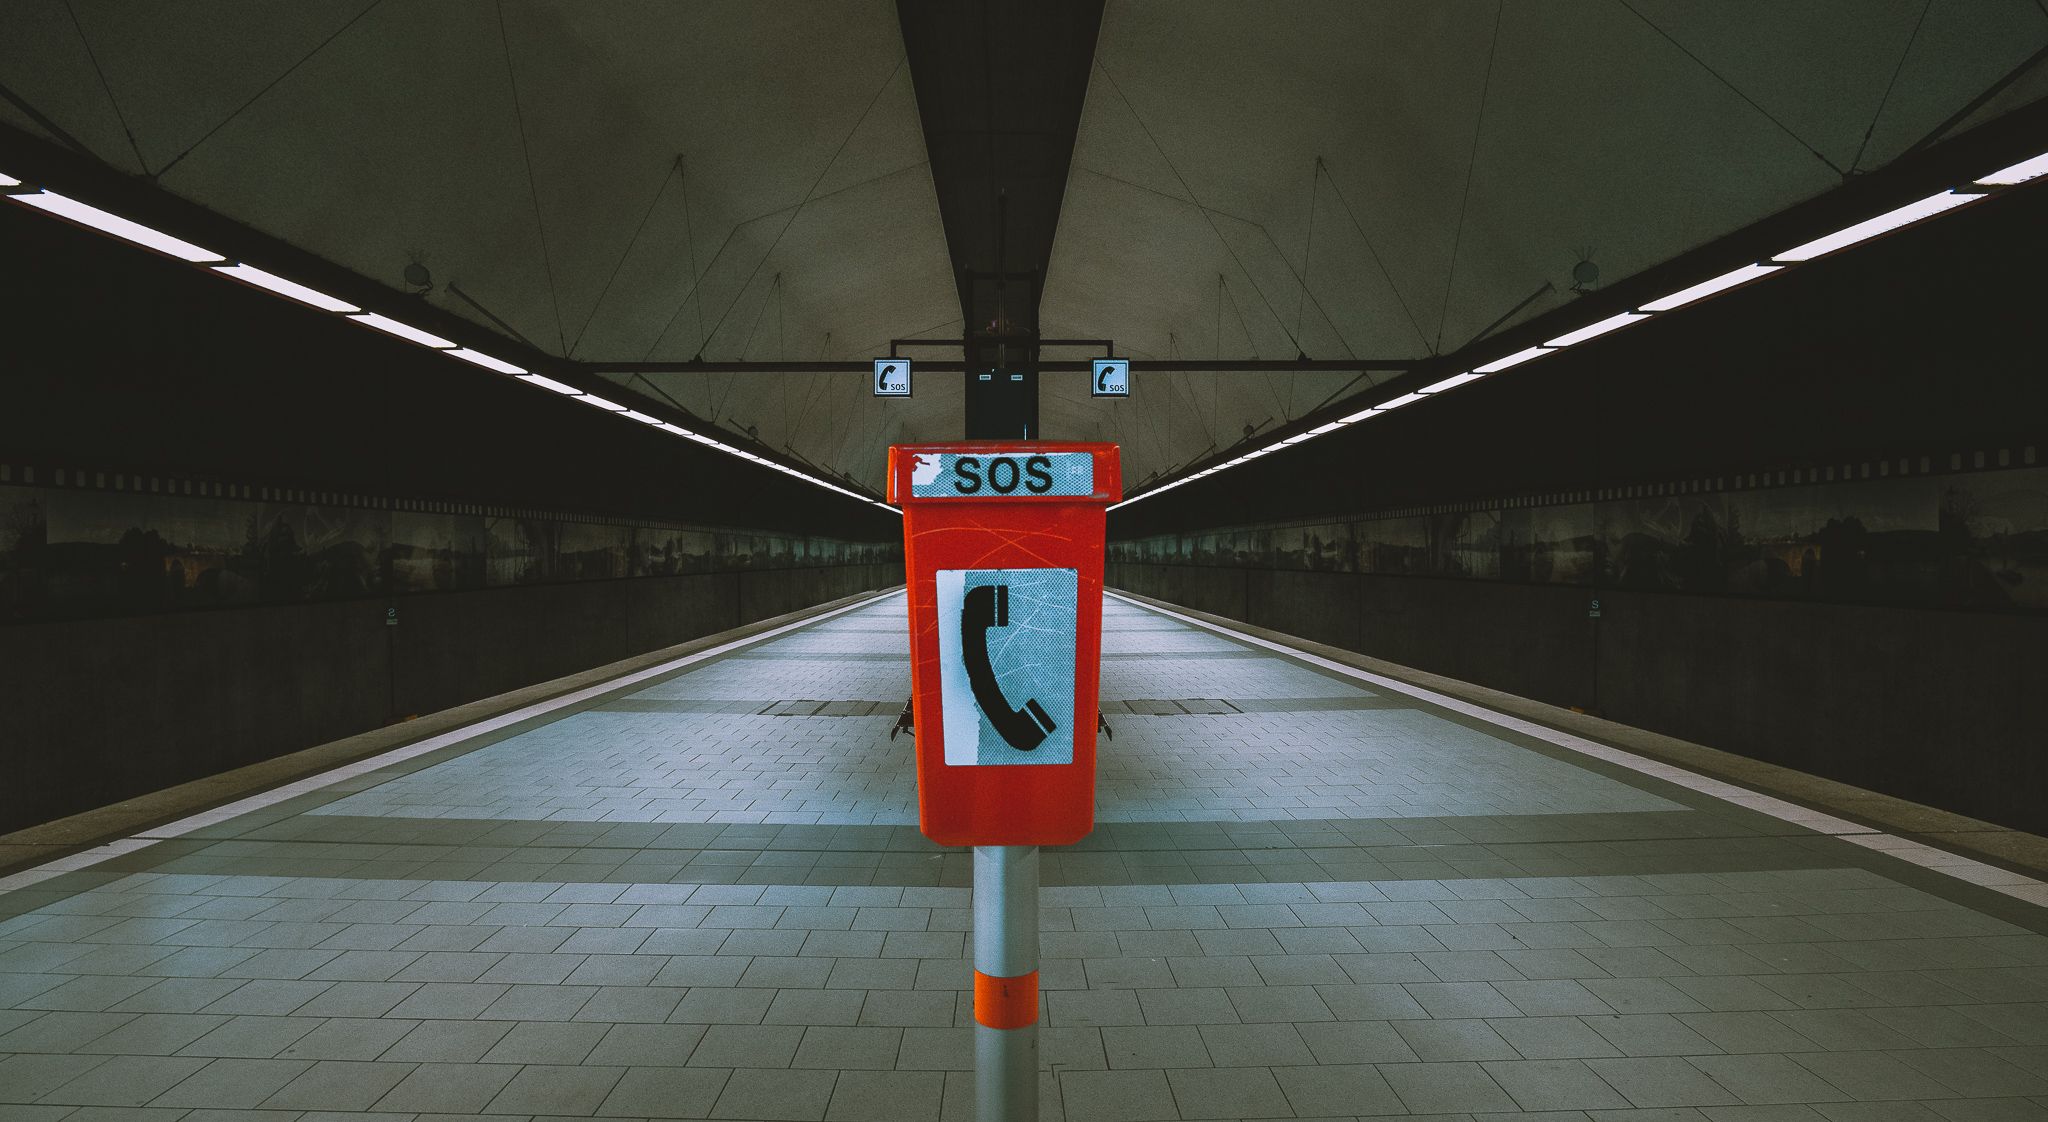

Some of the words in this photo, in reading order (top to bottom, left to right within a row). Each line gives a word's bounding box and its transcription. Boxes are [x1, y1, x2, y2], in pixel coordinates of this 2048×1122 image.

[890, 383, 906, 391] SOS
[1109, 384, 1125, 392] SOS
[953, 456, 1053, 494] SOS
